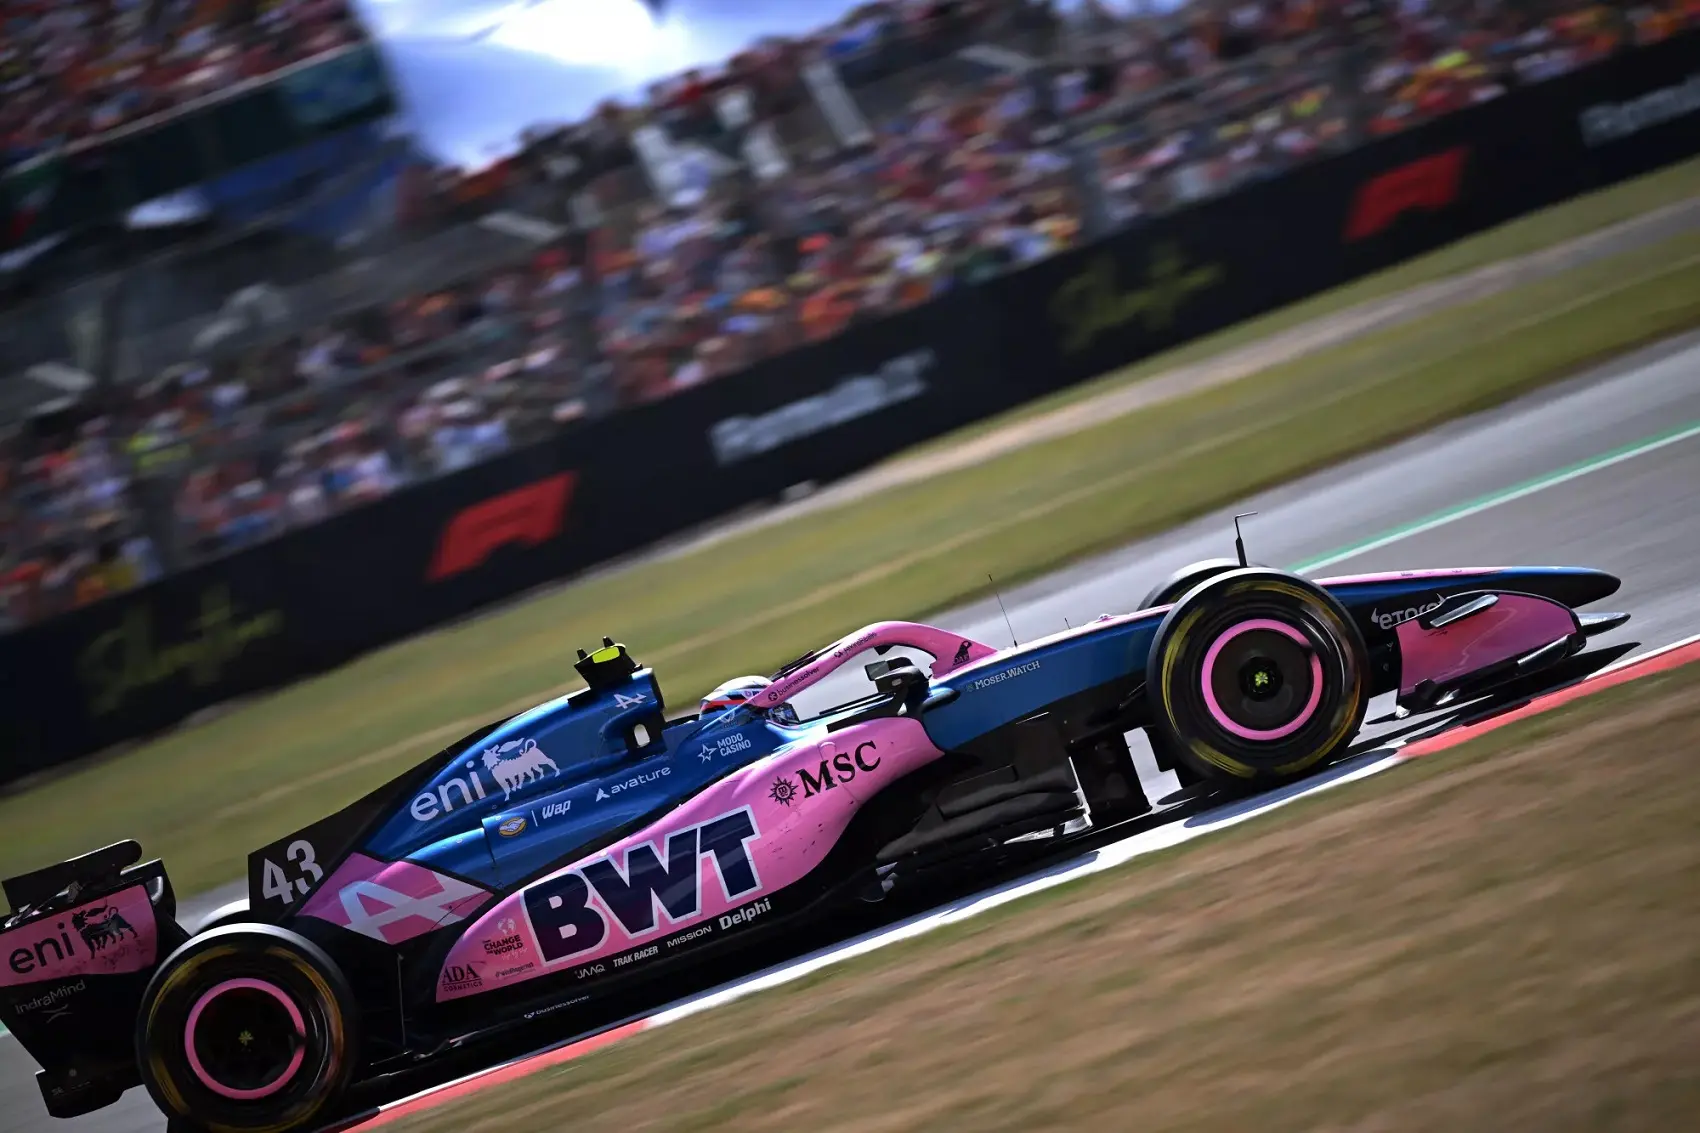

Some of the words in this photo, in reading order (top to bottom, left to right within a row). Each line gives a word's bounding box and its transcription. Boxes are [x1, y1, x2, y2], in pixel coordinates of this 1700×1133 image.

[777, 666, 820, 696] businessolver
[717, 733, 743, 749] MODO
[720, 739, 751, 757] CASINO
[611, 766, 672, 794] avature
[795, 740, 881, 798] MSC
[410, 761, 486, 821] eni
[541, 800, 571, 819] Wap
[262, 839, 324, 905] 43
[520, 804, 762, 967] BWT
[719, 898, 773, 930] Delphi
[9, 922, 75, 974] eni
[484, 934, 521, 951] CHANGE
[493, 942, 523, 955] WORLD
[667, 925, 712, 948] MISSION
[613, 955, 633, 968] TRAK
[634, 946, 658, 961] RACER
[442, 963, 480, 983] ADA
[14, 979, 86, 1015] IndraMind
